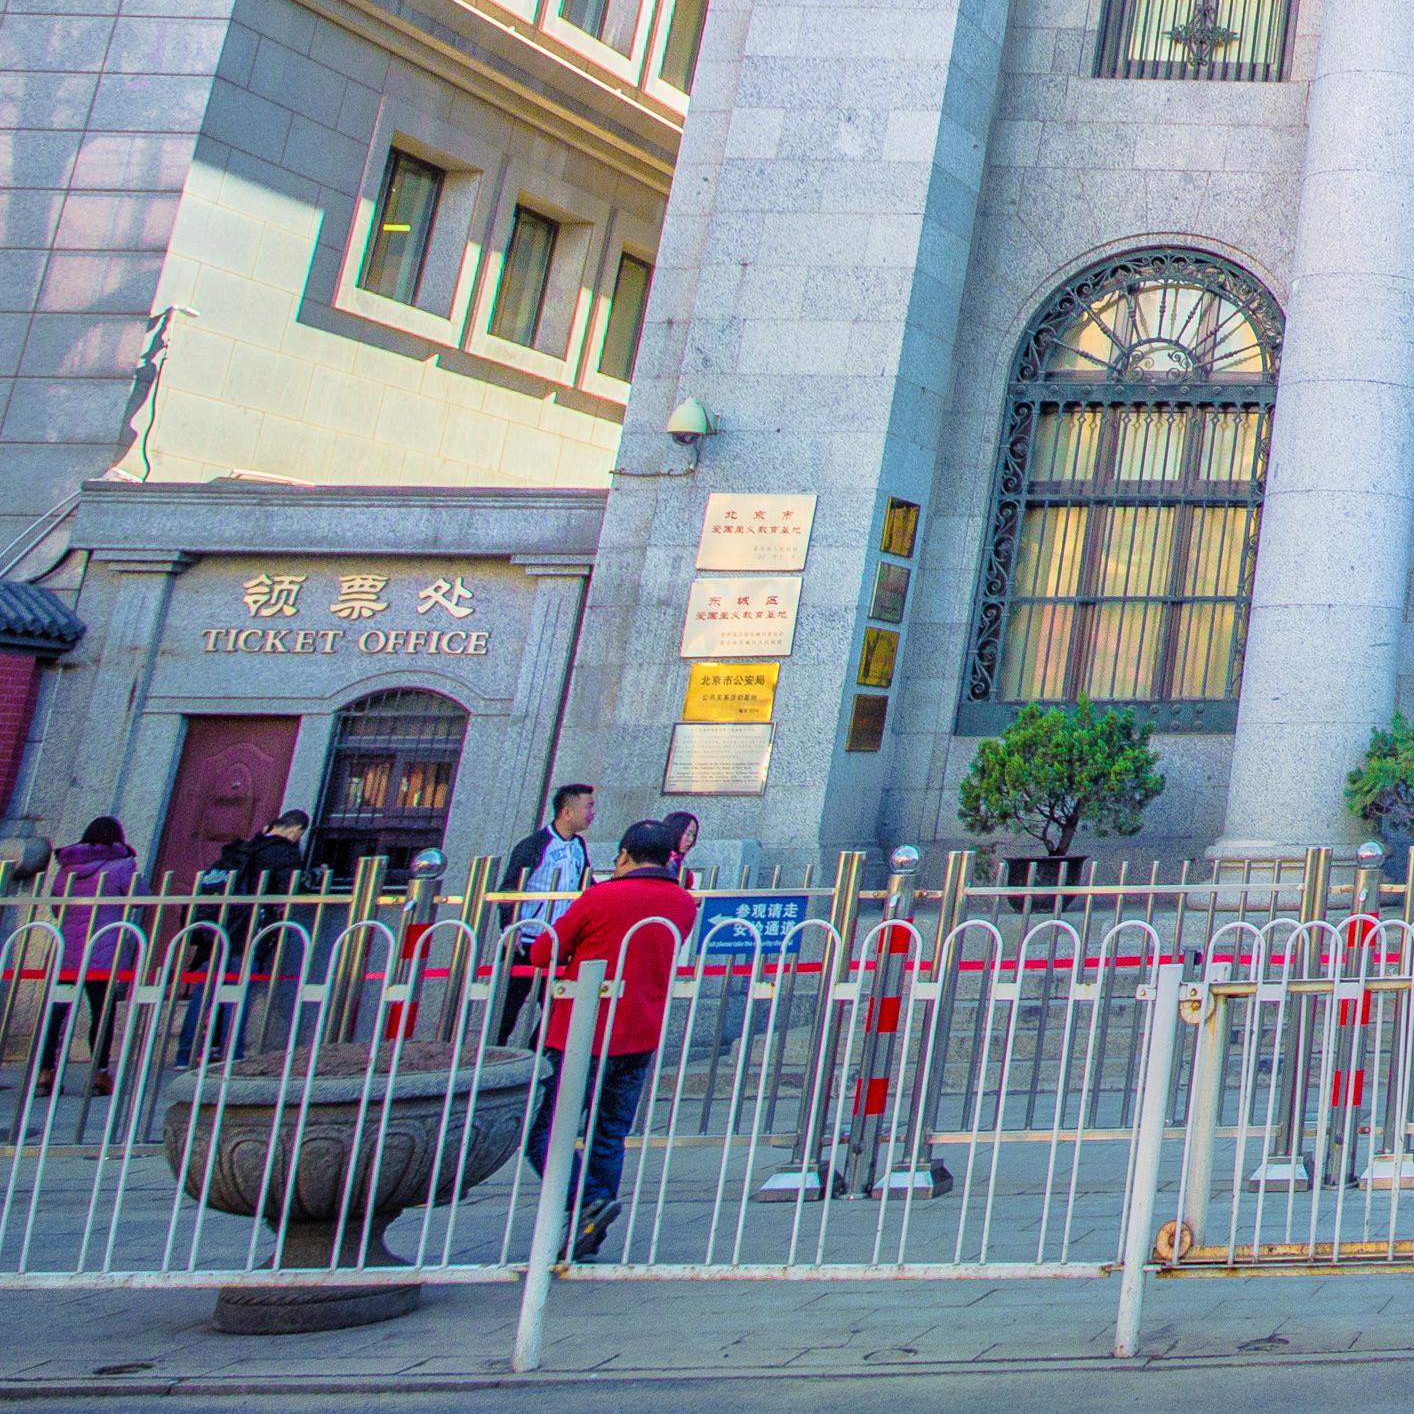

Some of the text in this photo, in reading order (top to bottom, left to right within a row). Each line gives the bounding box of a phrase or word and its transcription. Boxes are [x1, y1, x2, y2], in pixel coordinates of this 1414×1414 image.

[724, 509, 794, 521] 北京市
[243, 573, 475, 620] 领票处
[707, 594, 779, 607] 东城区
[203, 628, 489, 655] TICKET OFFICE
[700, 674, 766, 686] 北京市公安局
[735, 902, 799, 919] 参观请走
